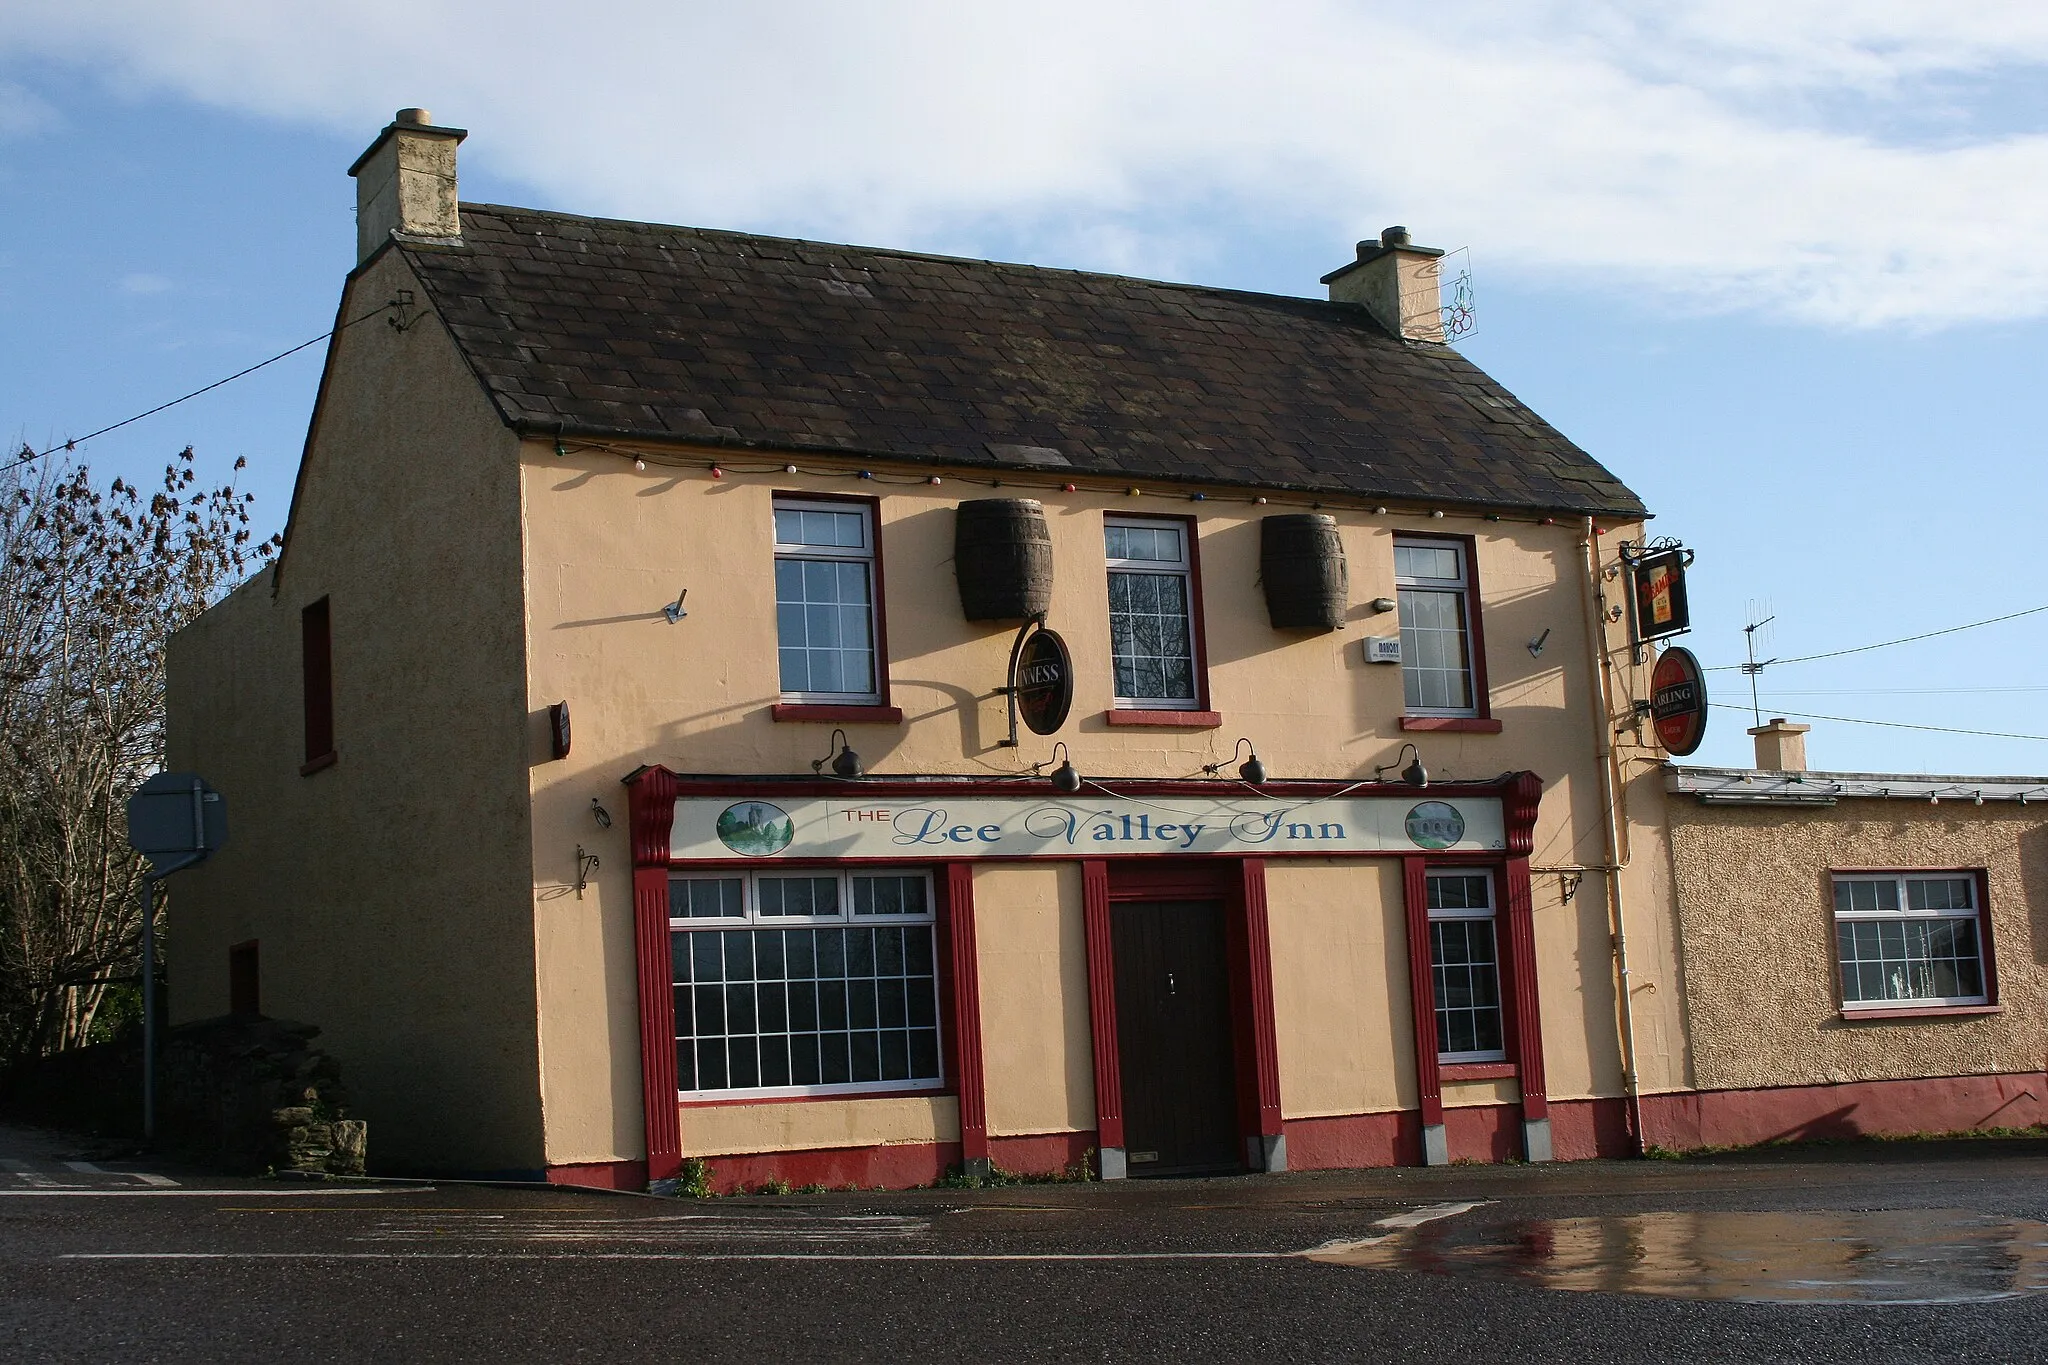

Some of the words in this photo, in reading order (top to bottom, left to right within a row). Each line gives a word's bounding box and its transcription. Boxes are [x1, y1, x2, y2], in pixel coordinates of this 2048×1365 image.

[1653, 688, 1691, 709] CARLING
[841, 809, 890, 822] THE
[891, 808, 1001, 845] Lee
[1025, 807, 1206, 848] Valley
[1229, 808, 1346, 843] Inn
